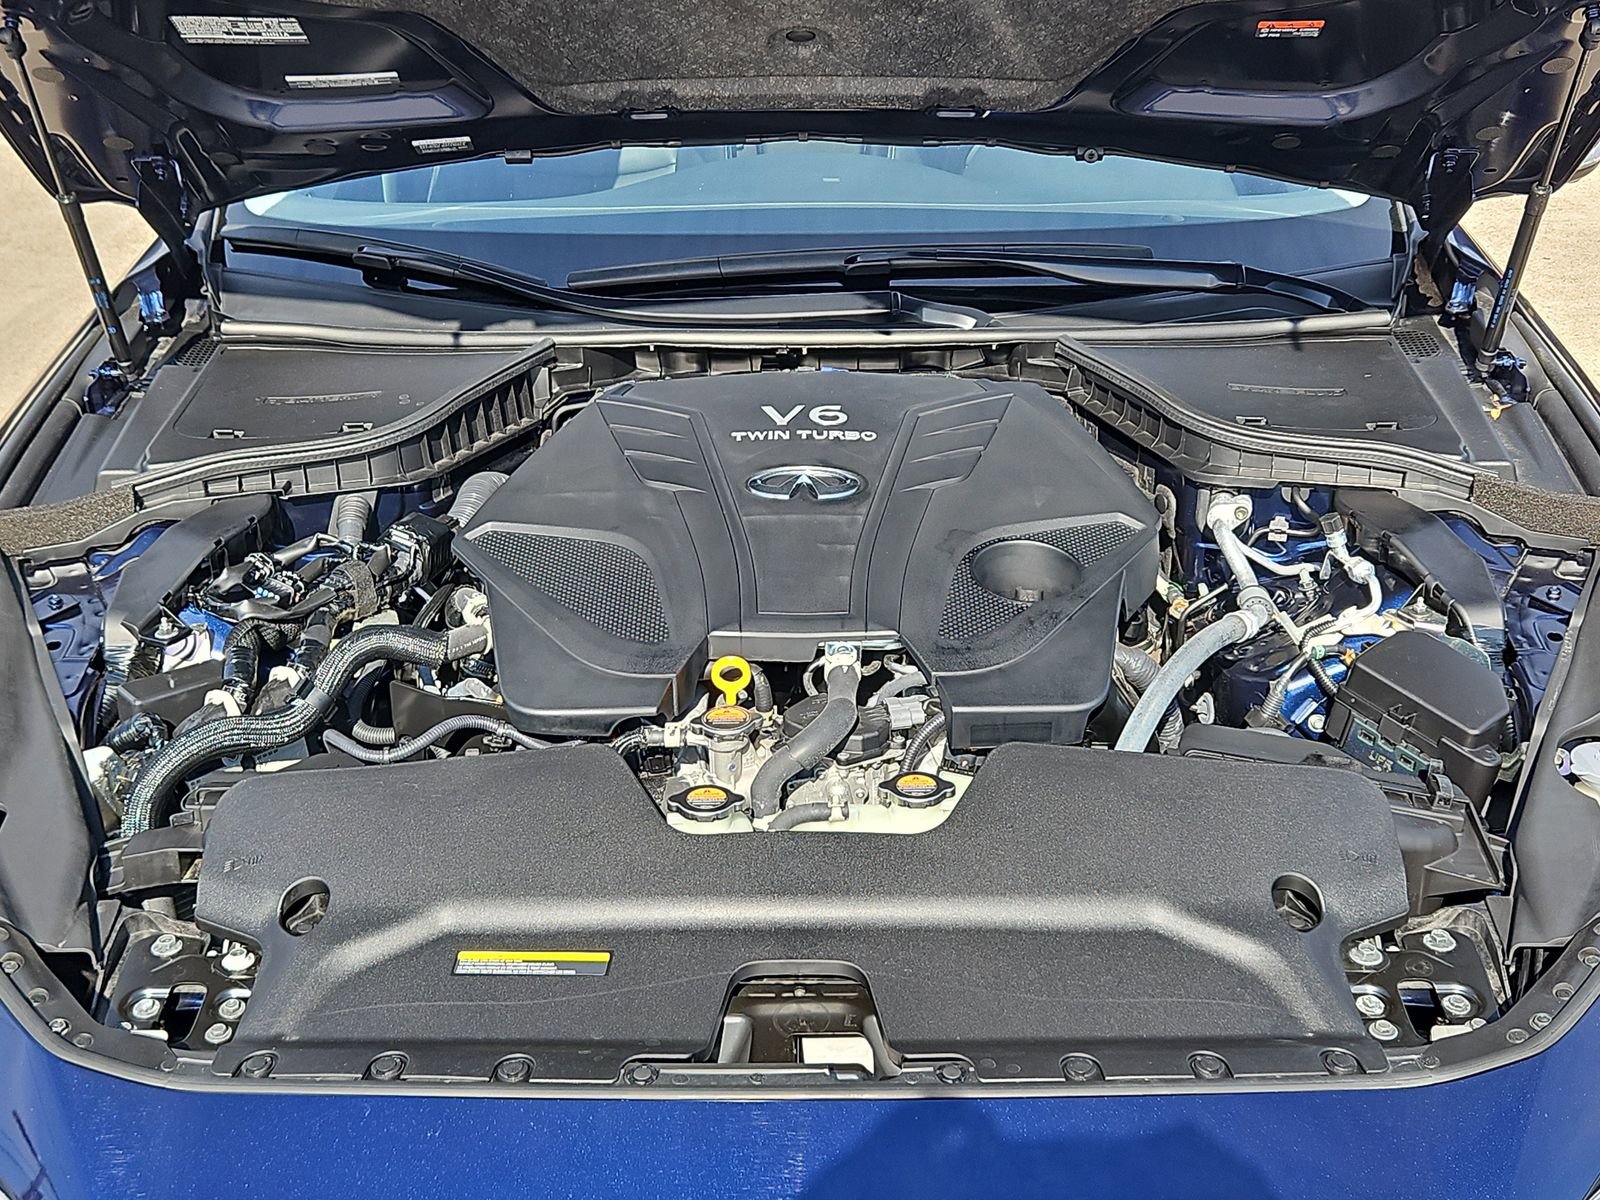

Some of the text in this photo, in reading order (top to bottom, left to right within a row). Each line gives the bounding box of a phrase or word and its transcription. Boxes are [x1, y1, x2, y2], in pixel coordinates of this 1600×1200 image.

[760, 404, 849, 426] V6
[730, 430, 878, 442] TWIN TURBO
